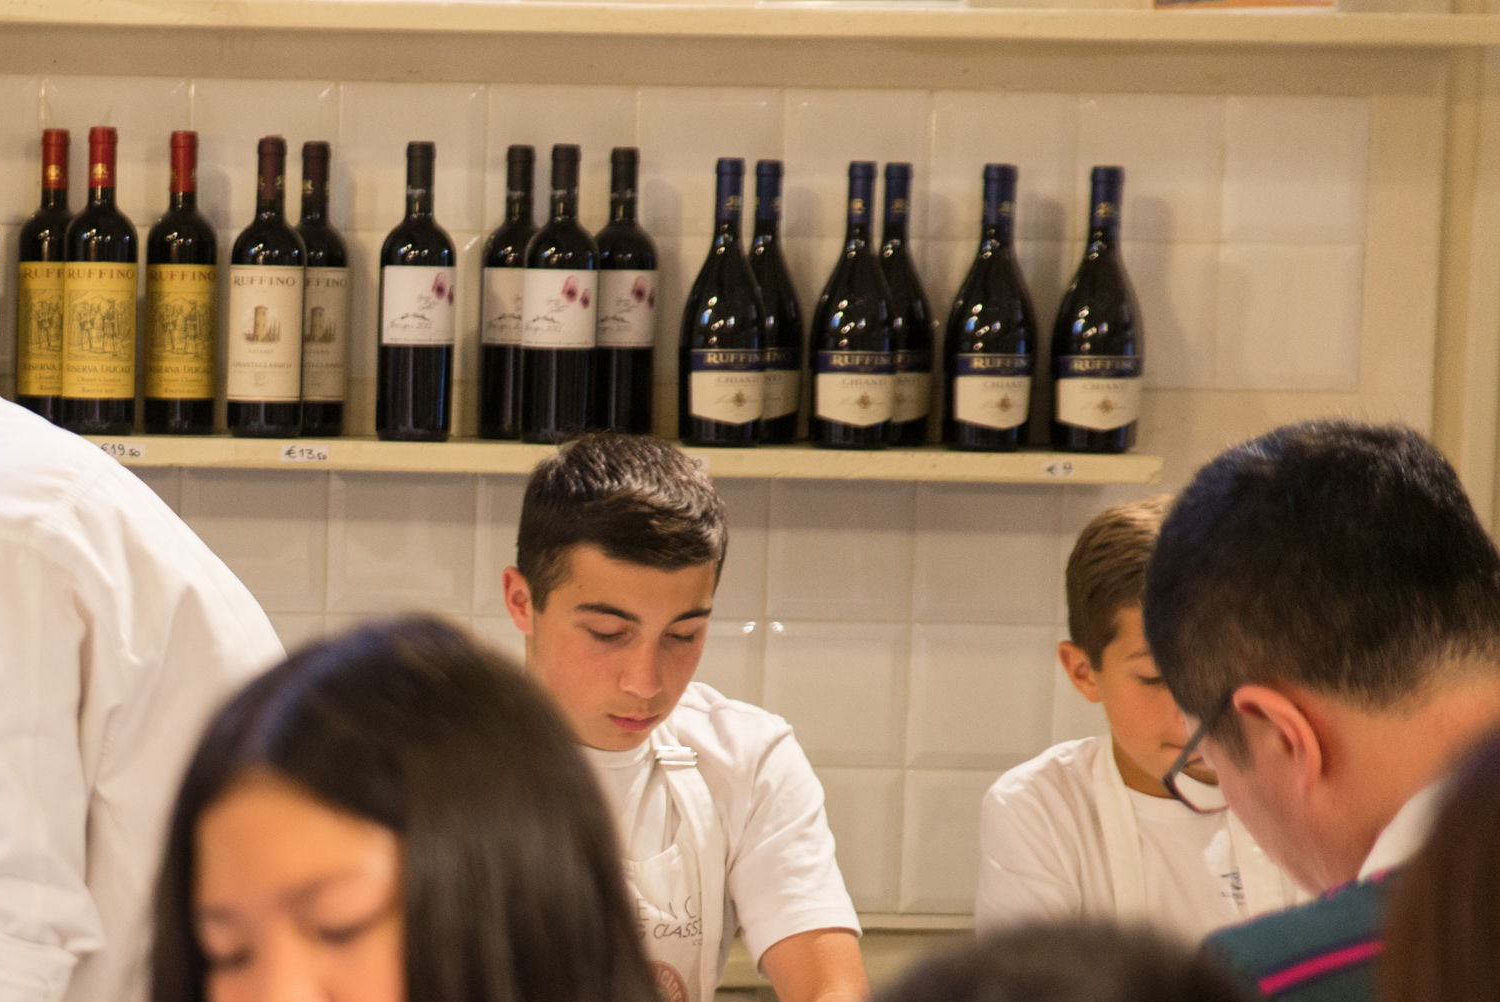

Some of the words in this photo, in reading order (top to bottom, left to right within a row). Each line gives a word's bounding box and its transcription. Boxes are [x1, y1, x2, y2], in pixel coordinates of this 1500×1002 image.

[24, 267, 64, 280] RUFF
[67, 267, 135, 280] RUFFINO
[150, 269, 217, 281] RUFFINO
[233, 275, 296, 287] RUFFINO
[705, 352, 761, 364] RUFFIN
[831, 354, 889, 367] RUFFIN
[972, 356, 1027, 369] RUFFIN
[653, 919, 703, 940] CLASS
